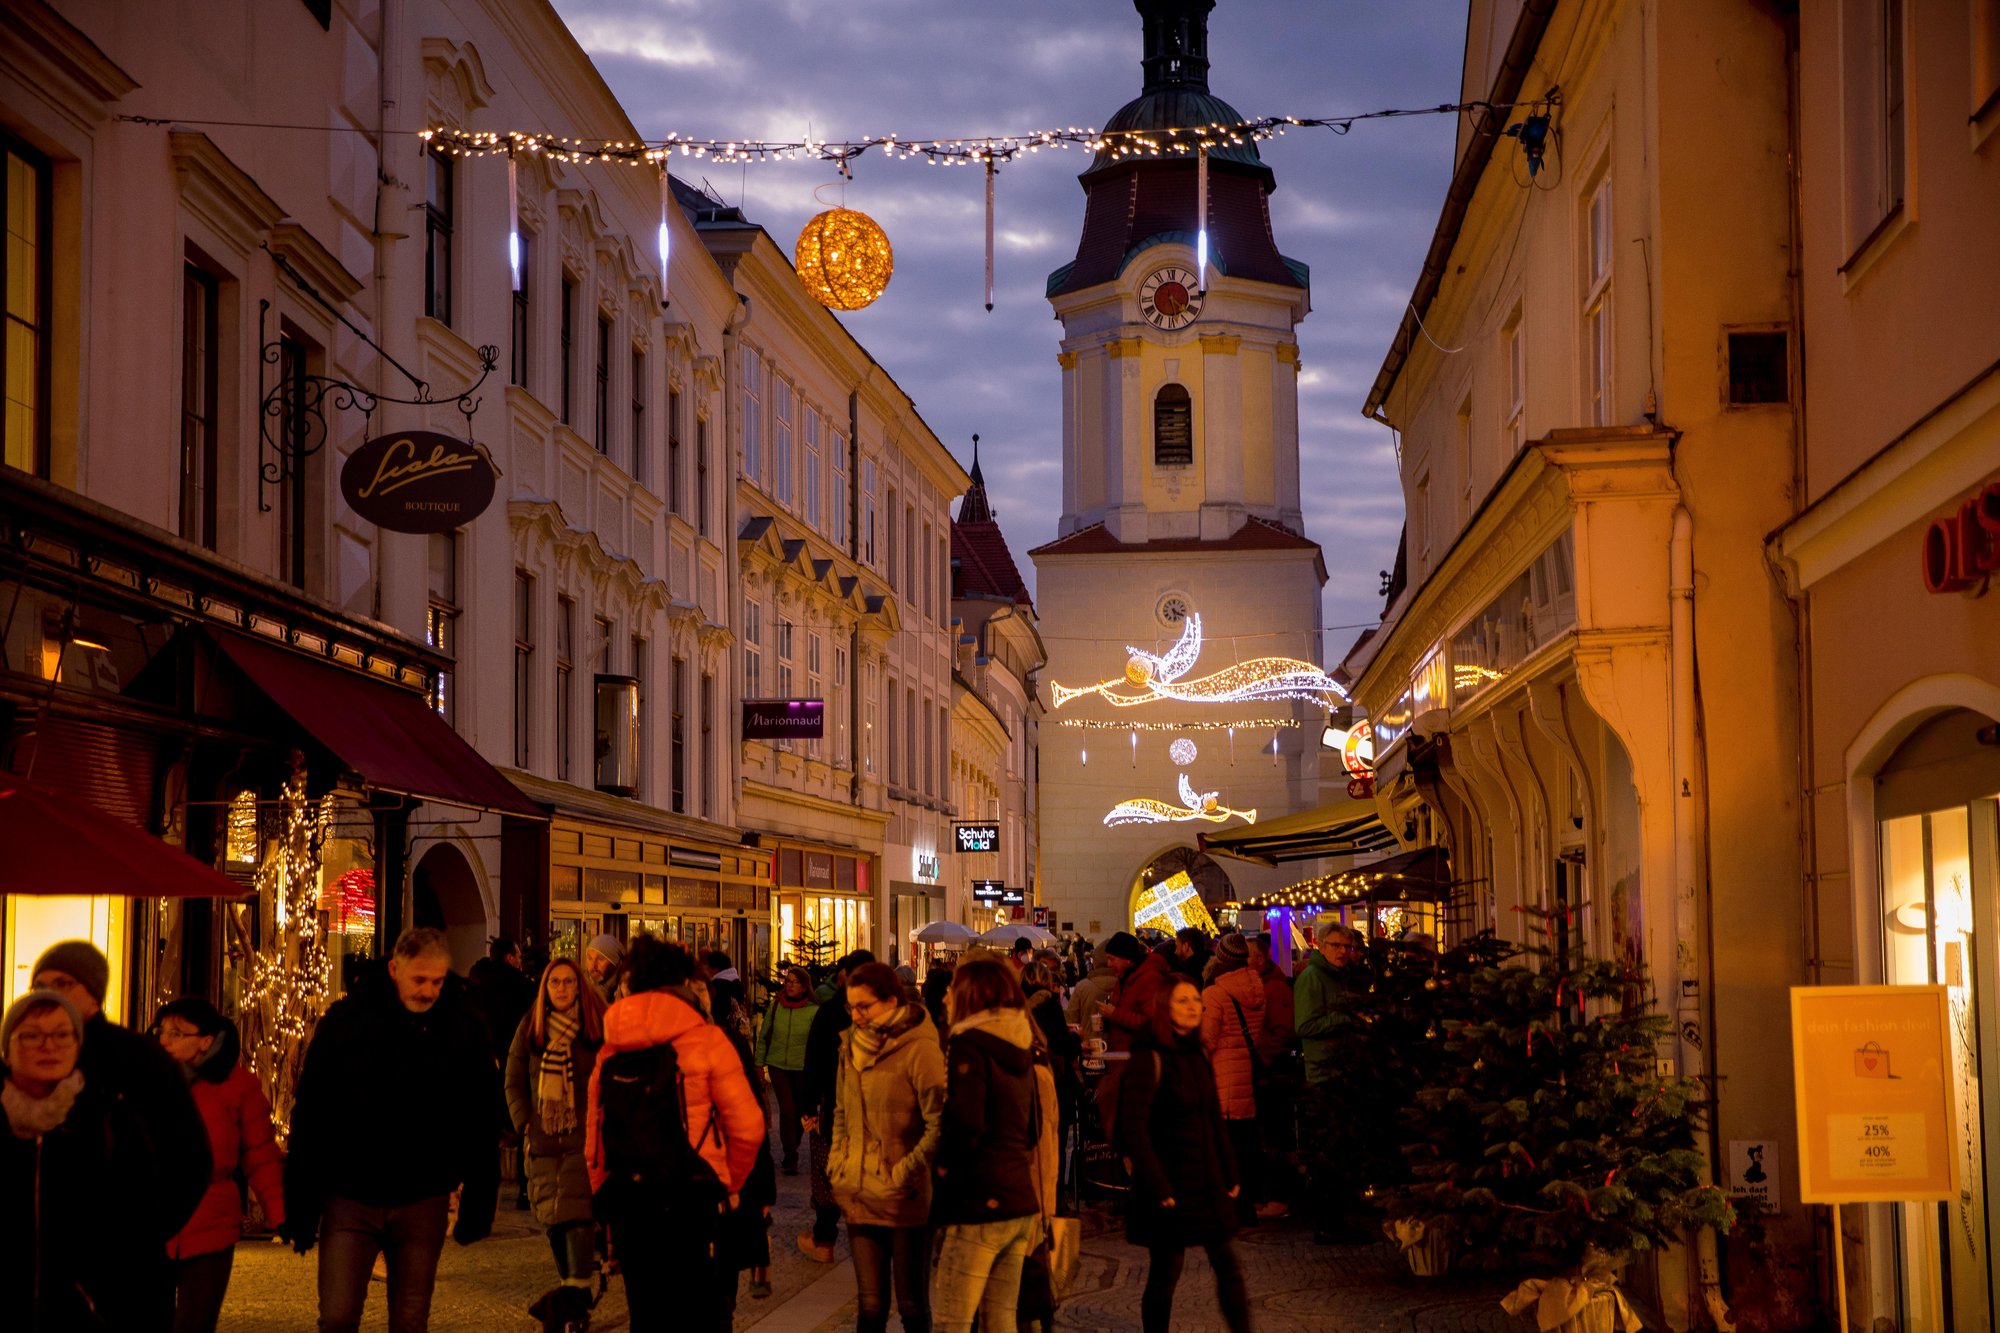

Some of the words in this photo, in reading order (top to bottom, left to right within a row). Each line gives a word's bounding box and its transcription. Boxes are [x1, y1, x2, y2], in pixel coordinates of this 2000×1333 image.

[358, 439, 478, 498] Scala
[405, 502, 461, 512] BOUTIQUE
[747, 713, 821, 729] Marionnaud
[958, 827, 996, 840] Schuhe
[963, 838, 990, 850] Mold
[1807, 1018, 1839, 1033] dein
[1844, 1016, 1898, 1033] fashion
[1864, 1124, 1890, 1136] 25%
[1865, 1146, 1891, 1158] 40%
